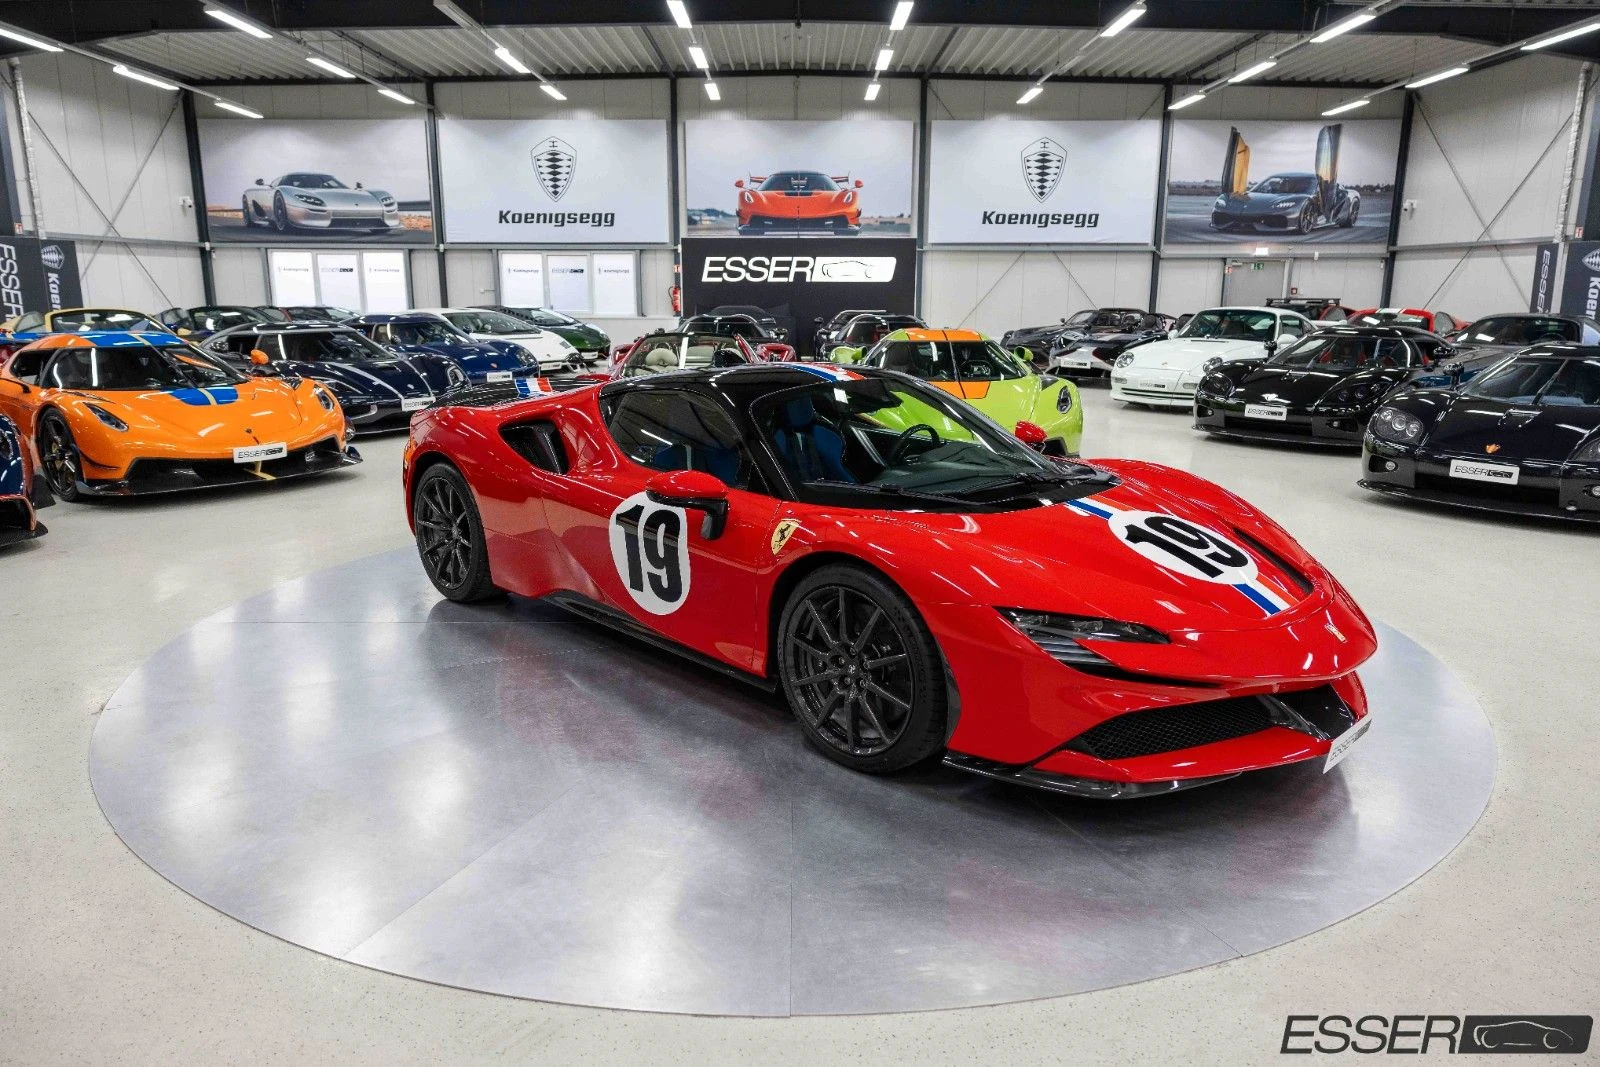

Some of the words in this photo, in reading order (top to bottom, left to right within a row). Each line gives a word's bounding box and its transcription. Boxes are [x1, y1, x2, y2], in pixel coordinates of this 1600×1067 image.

[498, 210, 615, 227] Koenigsegg
[982, 211, 1099, 228] Koenigsegg
[701, 256, 815, 282] ESSER
[238, 449, 266, 459] ESSER
[1454, 465, 1489, 476] ESSER
[616, 504, 683, 603] 19
[1124, 516, 1249, 578] 19
